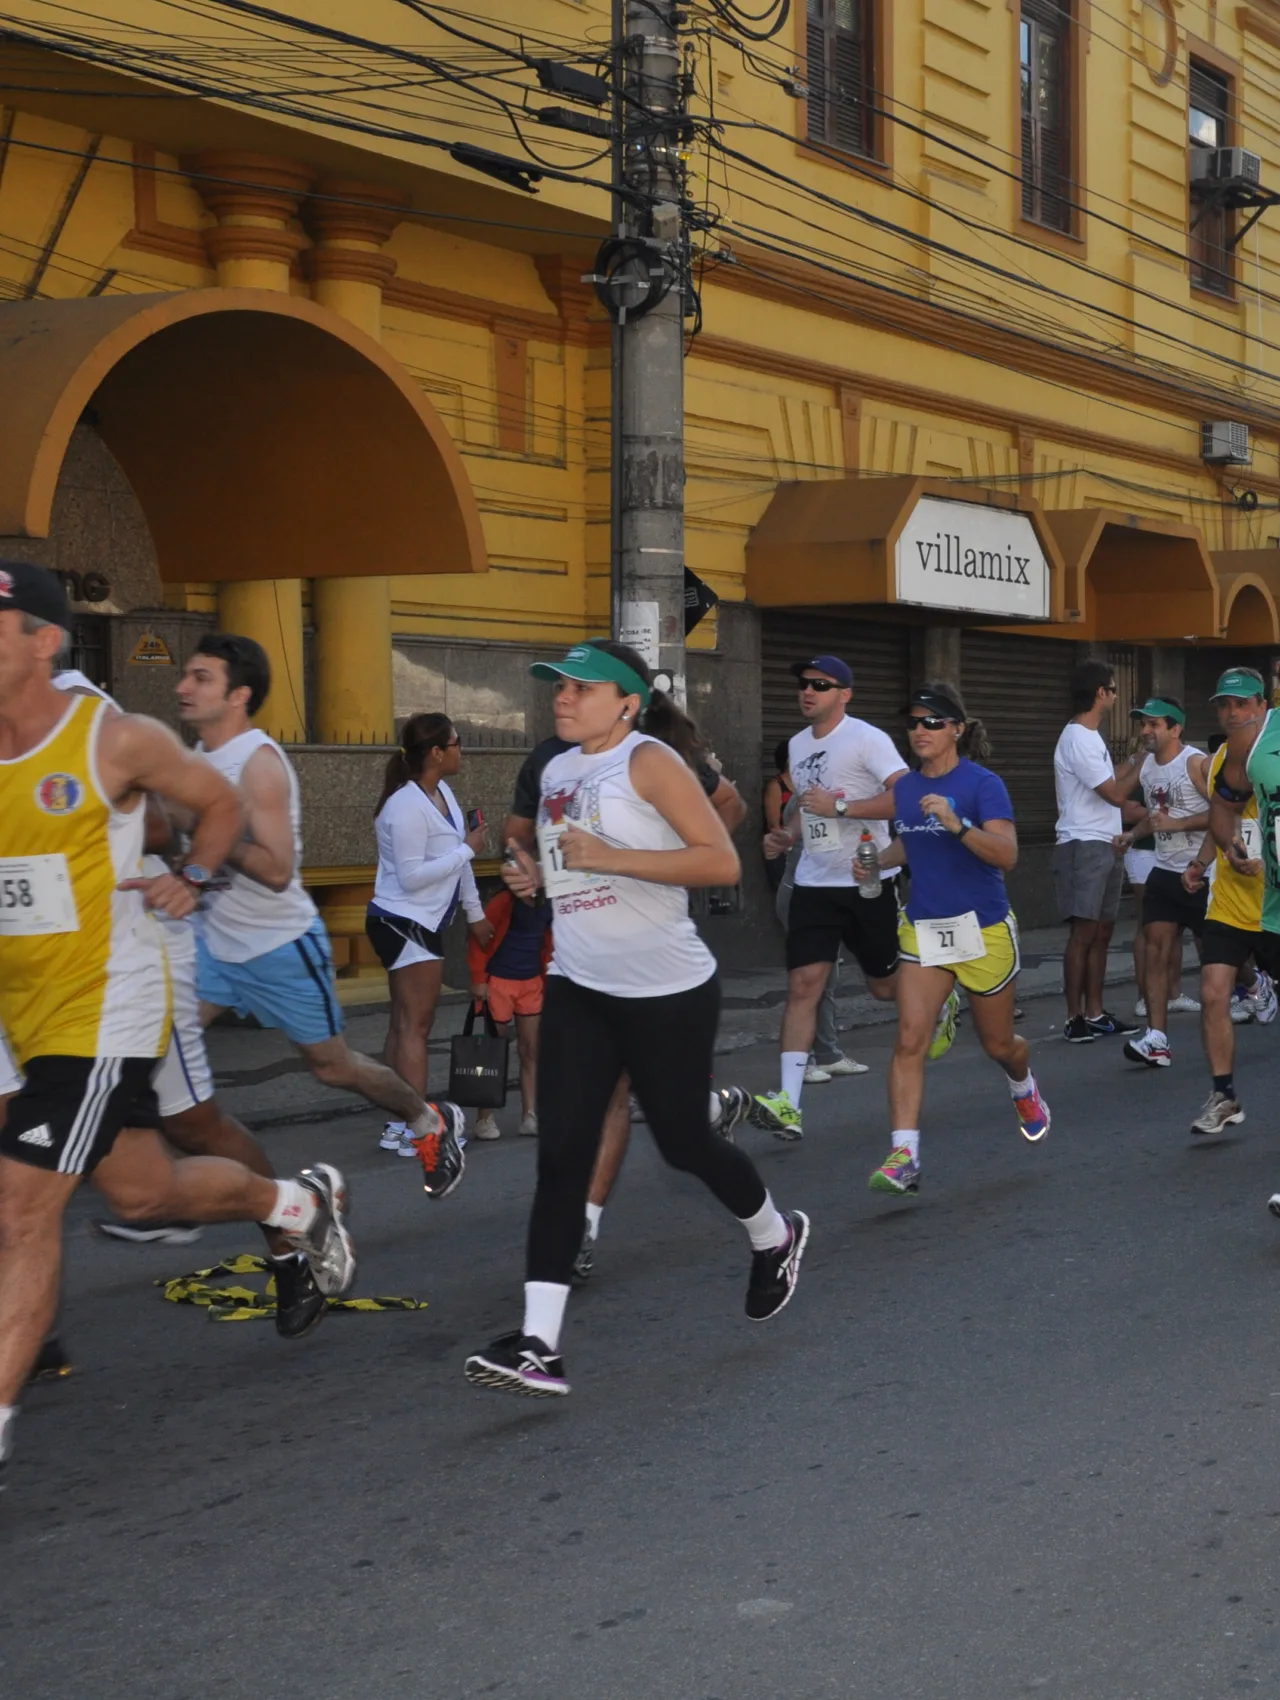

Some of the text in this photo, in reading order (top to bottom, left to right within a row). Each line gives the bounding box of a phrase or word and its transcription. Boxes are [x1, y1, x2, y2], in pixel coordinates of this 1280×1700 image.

[916, 532, 1030, 585] villamix
[0, 879, 33, 908] 58
[573, 895, 617, 912] Pedro
[937, 931, 954, 947] 27
